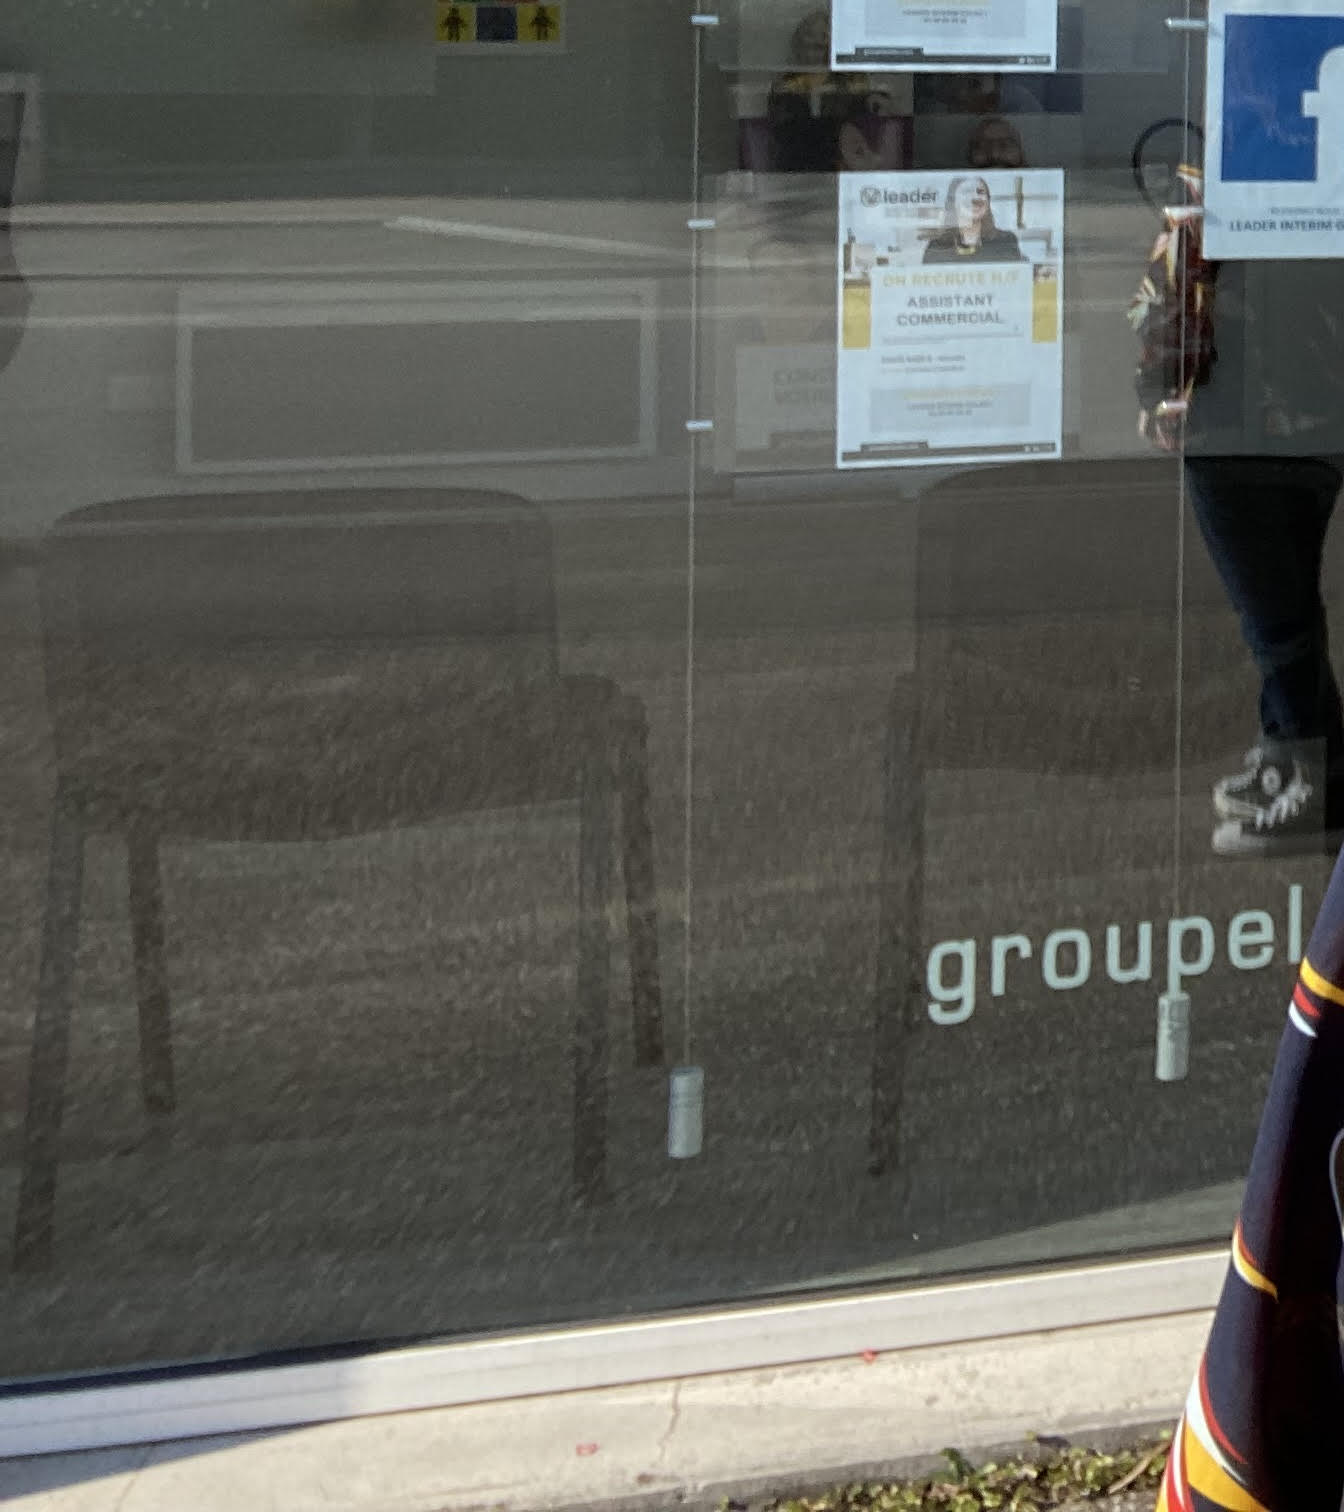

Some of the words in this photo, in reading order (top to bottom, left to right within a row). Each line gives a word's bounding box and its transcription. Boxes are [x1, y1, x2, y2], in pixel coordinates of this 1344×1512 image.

[883, 187, 938, 206] leader
[1229, 219, 1277, 232] LEADER
[907, 293, 994, 308] ASSISTANT
[897, 311, 1003, 326] COMMERCIAL
[926, 884, 1302, 1025] groupel
